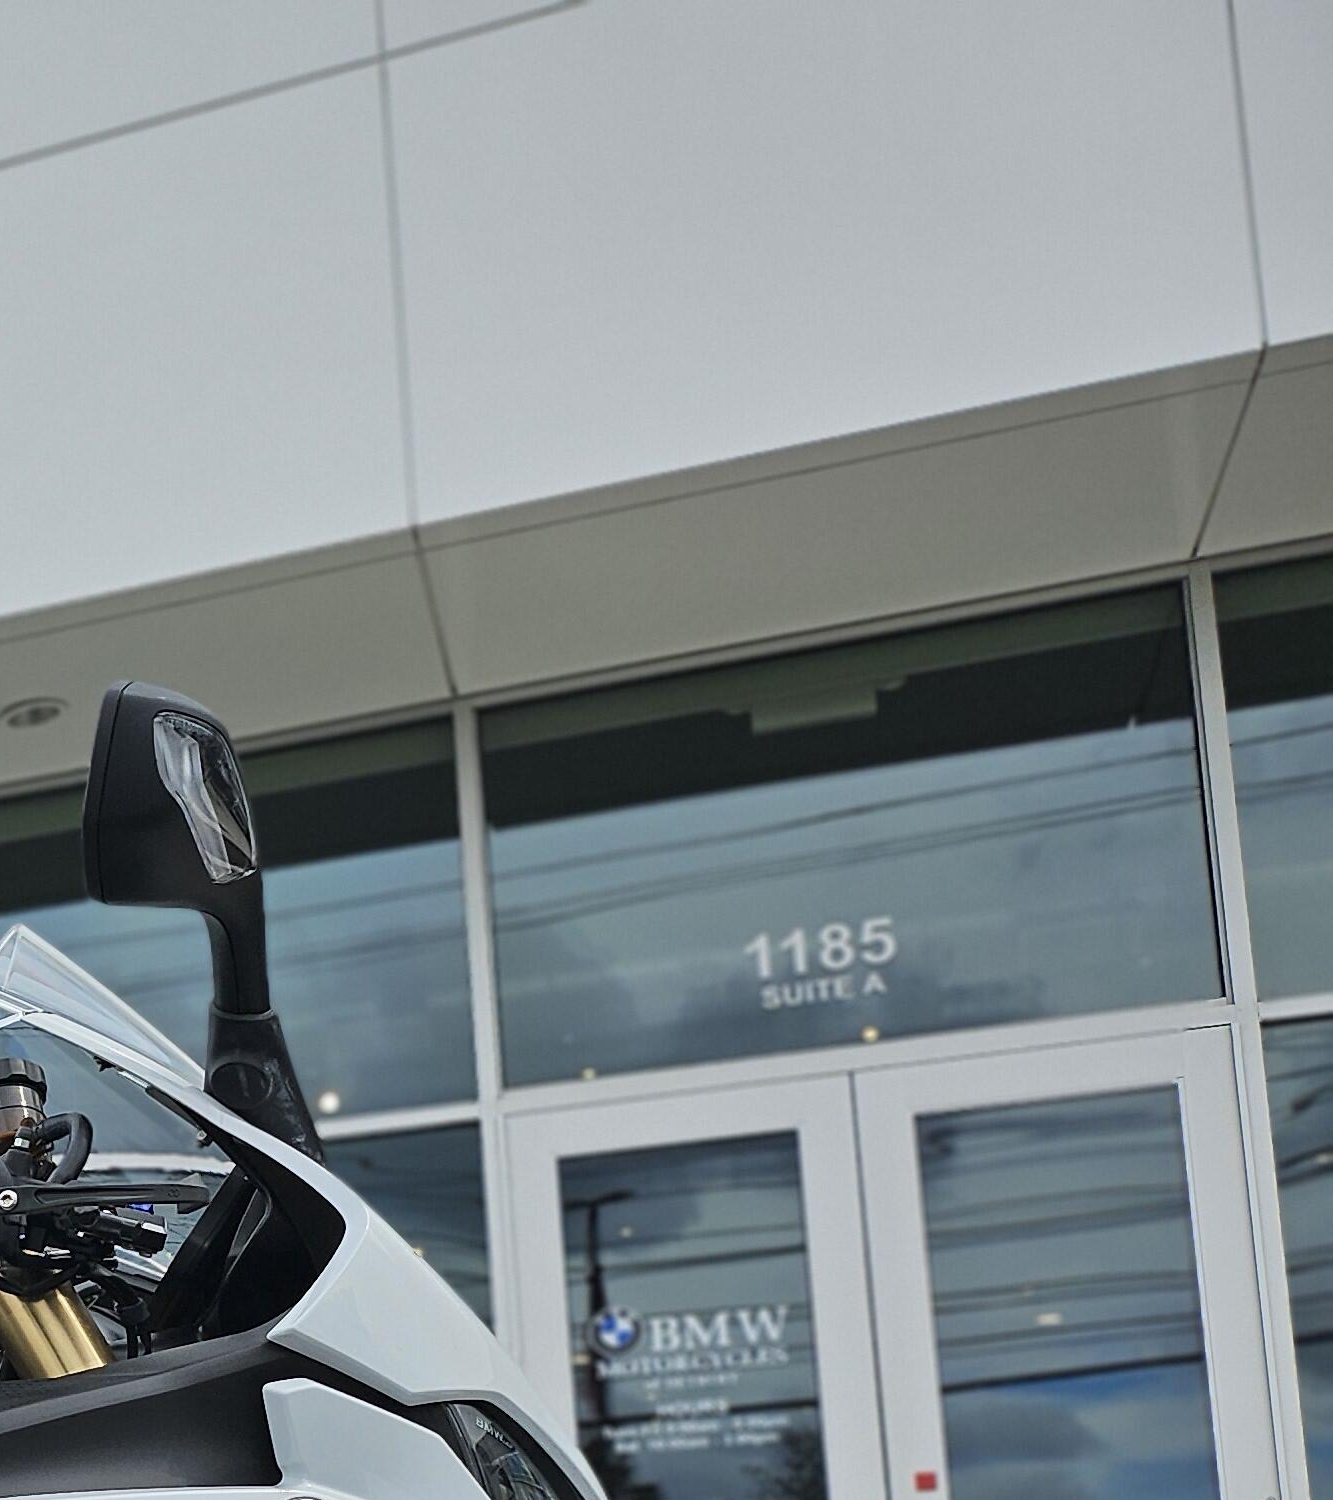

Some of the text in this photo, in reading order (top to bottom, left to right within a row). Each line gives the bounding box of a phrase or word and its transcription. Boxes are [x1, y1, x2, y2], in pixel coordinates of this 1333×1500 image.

[743, 916, 898, 979] 1185
[760, 970, 887, 1010] SUITE A
[650, 1304, 789, 1351] BMW
[475, 1416, 504, 1443] BMW
